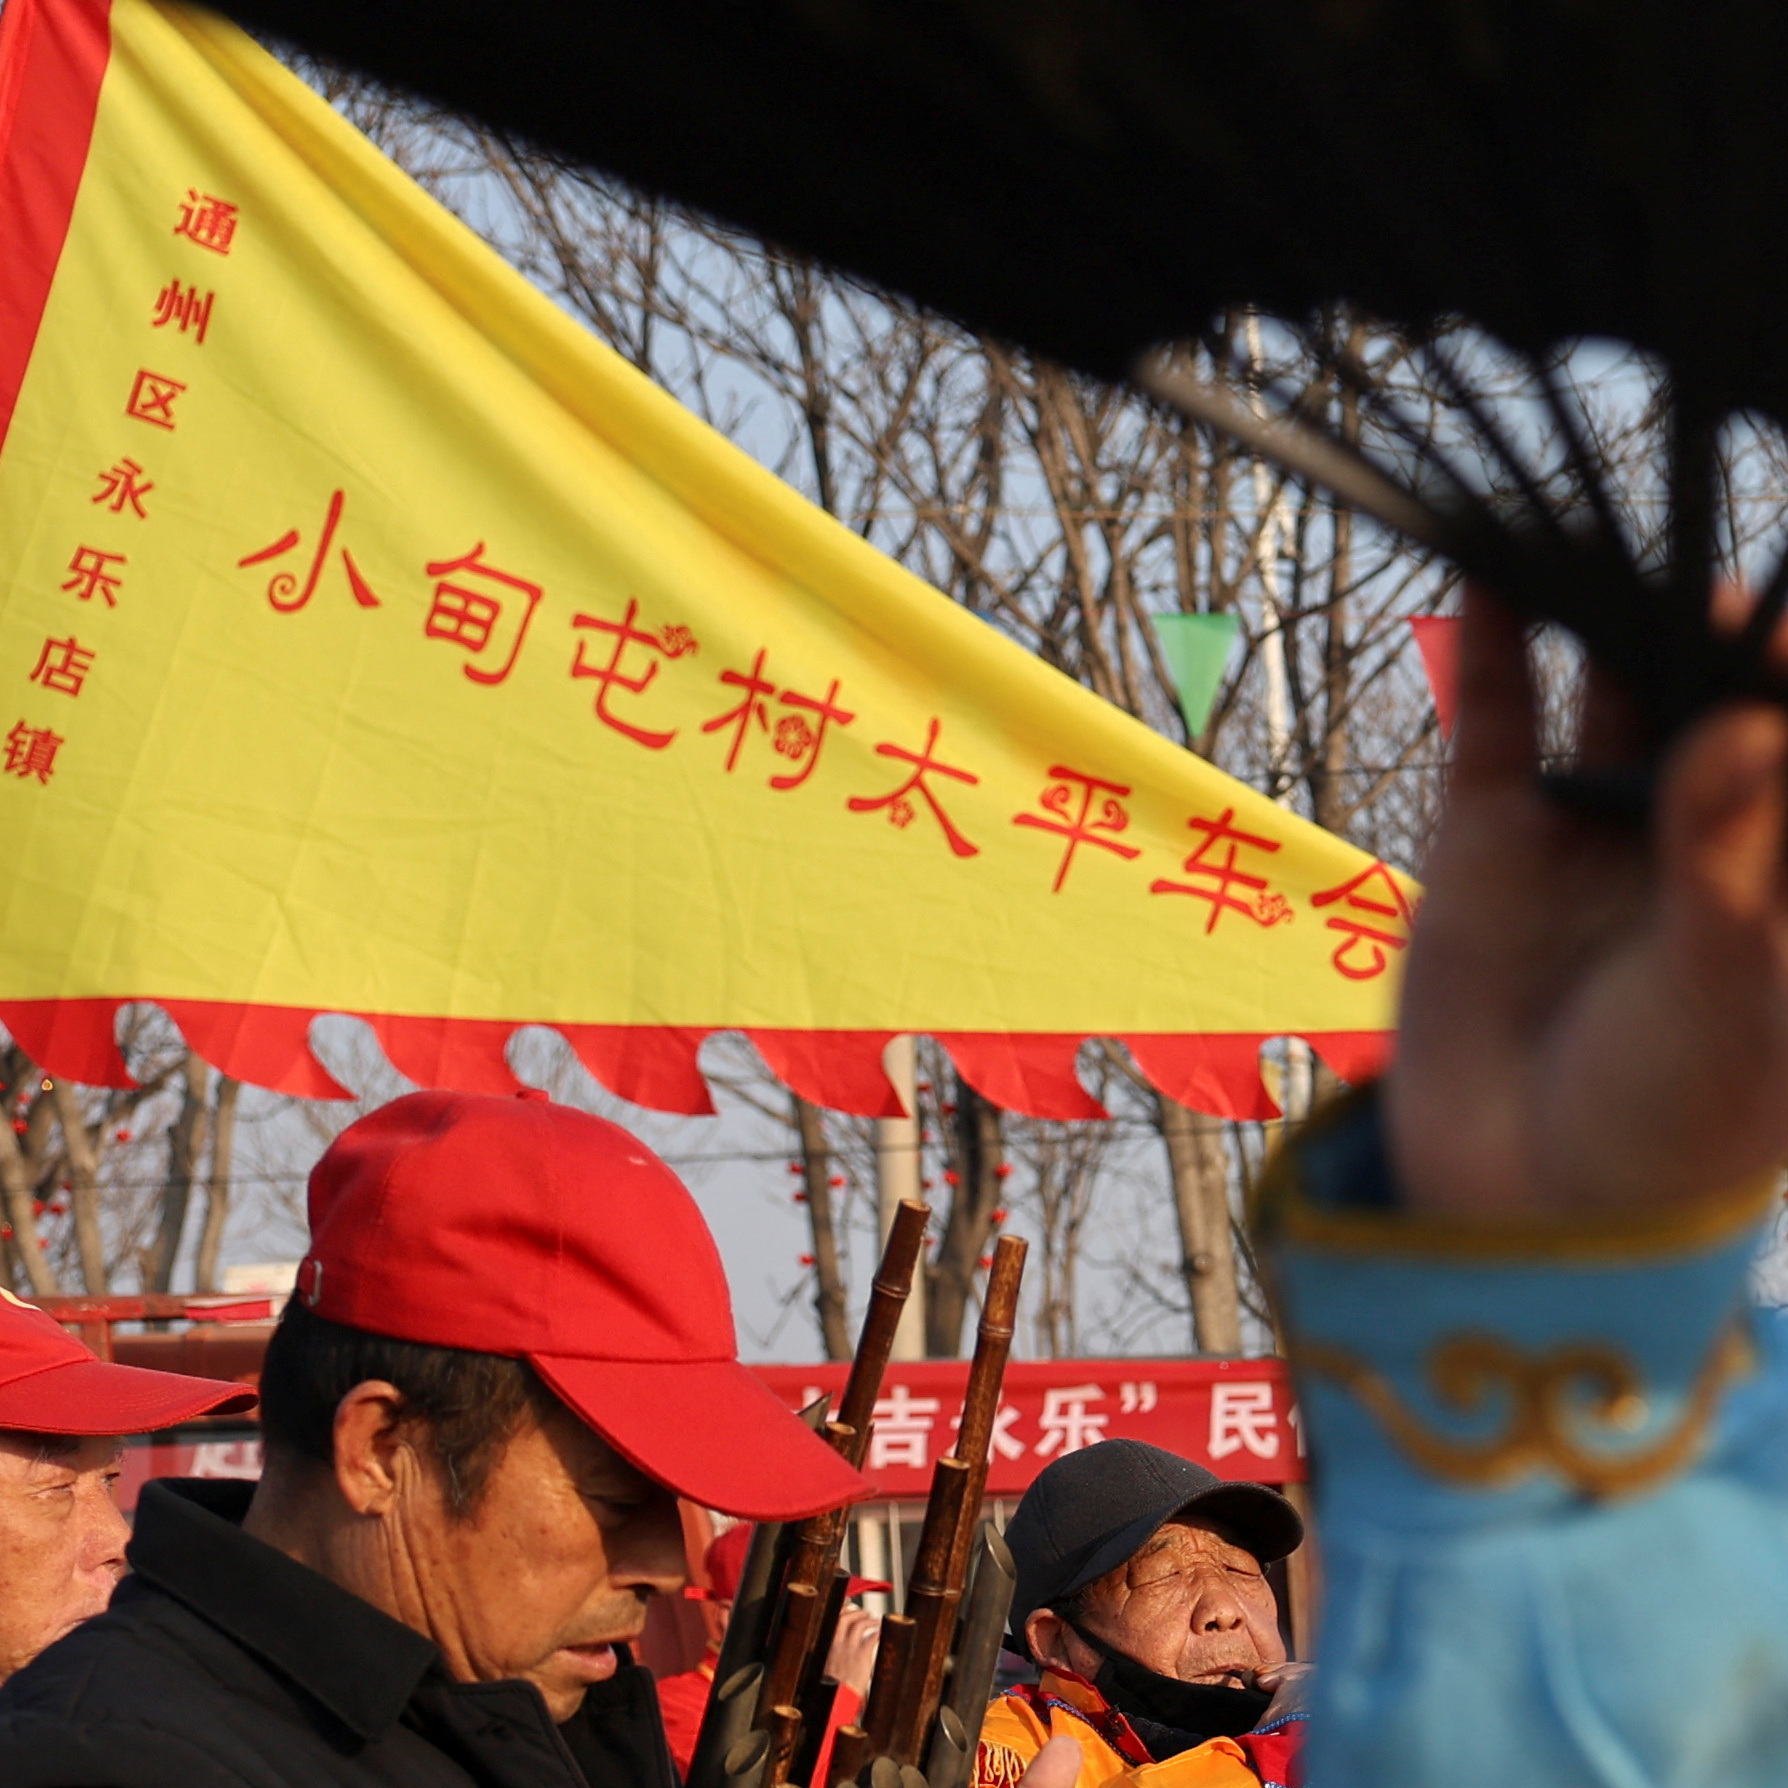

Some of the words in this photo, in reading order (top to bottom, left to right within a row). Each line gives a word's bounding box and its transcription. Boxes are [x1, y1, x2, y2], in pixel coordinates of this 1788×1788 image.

[3, 189, 239, 786] 通州区永乐店镇
[238, 489, 1416, 981] 小甸屯村太平车会
